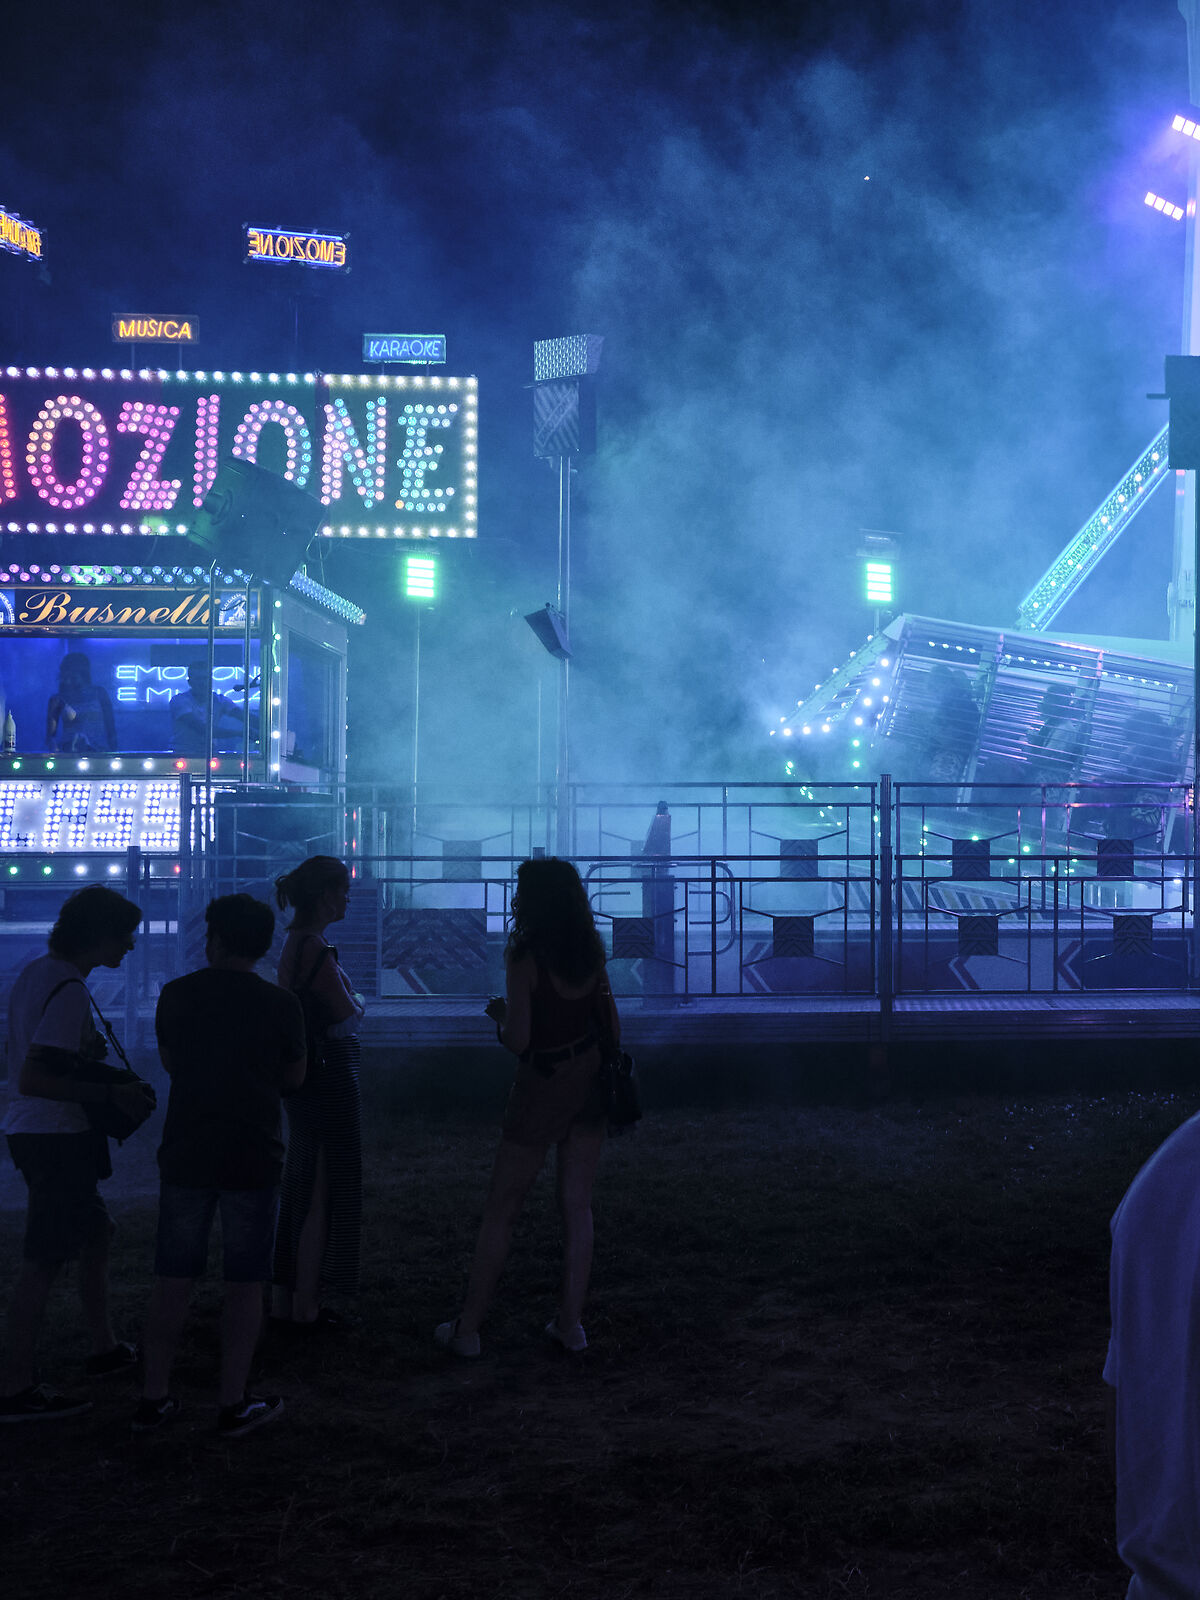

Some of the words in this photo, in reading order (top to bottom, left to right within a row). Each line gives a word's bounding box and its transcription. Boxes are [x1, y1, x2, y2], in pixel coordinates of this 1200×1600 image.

[118, 319, 193, 340] MUSICA
[369, 338, 442, 358] KARAOKE
[0, 393, 459, 513] OZIONE
[19, 590, 222, 627] Busnelli
[0, 782, 214, 848] CASS
